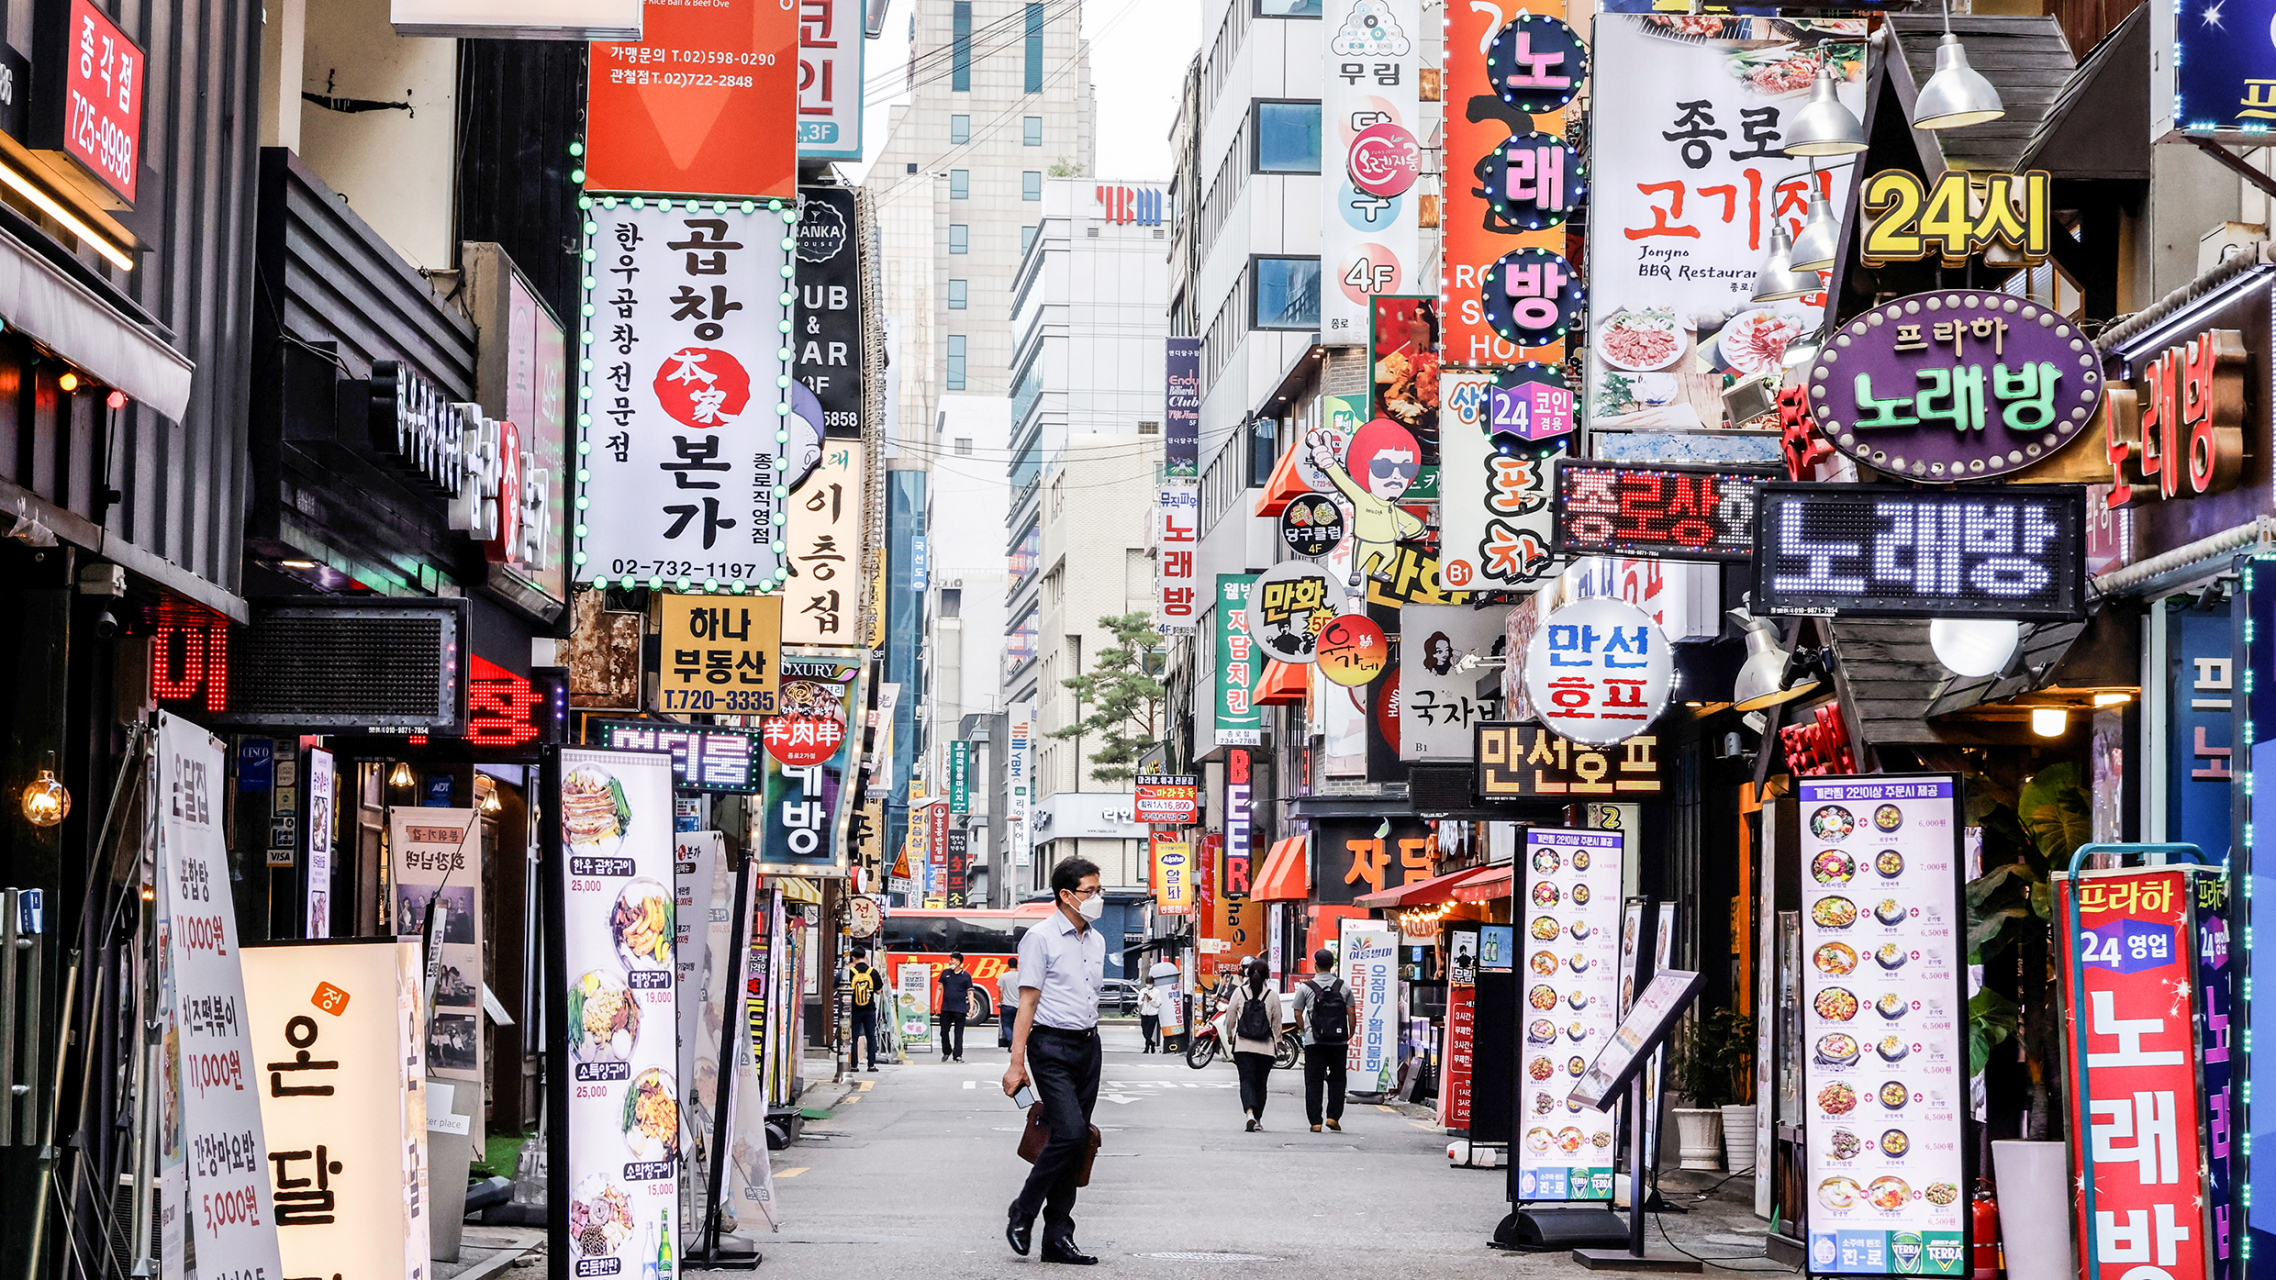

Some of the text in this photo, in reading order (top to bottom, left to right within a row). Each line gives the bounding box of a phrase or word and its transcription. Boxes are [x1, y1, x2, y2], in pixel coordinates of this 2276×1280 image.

[80, 14, 133, 114] 종각점
[610, 46, 776, 66] 가맹문의 T.02)598-0290
[610, 69, 650, 85] 관철점
[664, 72, 753, 89] 02)722-2848
[1339, 62, 1400, 86] 무림
[72, 89, 132, 186] 725-9998
[1662, 100, 1795, 169] 종로
[1505, 31, 1570, 330] 노래방
[1867, 173, 2048, 253] 24시
[1638, 244, 1690, 262] Jongno
[666, 218, 743, 341] 곱창
[1345, 257, 1394, 293] 4F
[1638, 264, 1673, 281] BBQ
[807, 316, 820, 334] &
[1331, 318, 1349, 328] 종로
[1894, 317, 2008, 357] 프라하
[666, 350, 741, 425] 本家
[1169, 369, 1199, 395] Endy
[1169, 396, 1199, 407] Club
[1534, 392, 1567, 417] 코인
[1853, 361, 2064, 431] 노래방
[1495, 393, 1529, 432] 24
[2107, 329, 2215, 509] 노래방
[1540, 418, 1563, 431] 겸용
[660, 435, 737, 550] 본가
[751, 452, 774, 545] 종로직영점
[1290, 502, 1338, 526] 武林
[1484, 455, 1550, 580] 포차
[1285, 526, 1341, 542] 당구클럽
[798, 482, 846, 635] 이층집
[1308, 543, 1322, 553] 4F
[1774, 500, 2057, 595] 노래방
[611, 558, 757, 580] 02-732-1197
[1164, 515, 1195, 616] 노래방
[1450, 565, 1470, 581] B1
[1263, 576, 1327, 623] 만화
[690, 608, 751, 642] 하나
[1158, 624, 1171, 634] 4F
[873, 650, 884, 659] 3F
[1319, 622, 1380, 672] 유가네
[1547, 625, 1648, 668] 만선
[673, 650, 766, 685] 부동산
[1226, 608, 1252, 714] 자담치킨
[664, 689, 774, 711] T.720-3335
[1547, 676, 1648, 720] 호프
[763, 718, 841, 747] 羊肉串
[243, 747, 269, 758] CESCO
[787, 752, 816, 761] 종로2가점
[1415, 743, 1428, 752] B1
[1011, 752, 1021, 777] YBM
[173, 753, 209, 825] 온달집
[432, 782, 449, 792] ADT
[1156, 788, 1196, 798] 마라중독
[1814, 785, 1938, 799] 계란찜 2인이상 주문시 제공
[1228, 749, 1250, 892] BEER
[1919, 819, 1946, 828] 6,000원
[1537, 834, 1613, 847] 계란찜 2인이상 주문시 제공
[271, 852, 291, 861] VISA
[686, 845, 701, 859] 본가
[1162, 855, 1186, 865] Alpha
[573, 858, 632, 876] 한우 곱창구이
[949, 856, 965, 889] 호프
[1920, 863, 1947, 871] 7,000원
[180, 856, 210, 902] 홍합탕
[571, 881, 601, 892] 25,000
[1166, 870, 1181, 900] 알파
[2078, 879, 2174, 914] 프라하
[1160, 906, 1182, 914] 종로점
[177, 914, 227, 961] 11,000원
[1921, 929, 1948, 937] 6,500원
[2081, 930, 2121, 968] 24
[2127, 933, 2168, 961] 영업
[2201, 927, 2216, 965] 24
[631, 973, 669, 988] 대창구이
[1921, 971, 1949, 980] 6,500원
[646, 992, 672, 1003] 19,000
[183, 996, 238, 1038] 치즈떡볶이
[1922, 1022, 1951, 1030] 6,500원
[187, 1050, 244, 1099] 11,000원
[578, 1064, 629, 1080] 소특양구이
[1923, 1066, 1952, 1074] 6,500원
[577, 1086, 607, 1098] 25,000
[1924, 1113, 1953, 1121] 6,500원
[2087, 990, 2190, 1280] 노래방
[193, 1130, 257, 1178] 간장마요밥
[1925, 1142, 1954, 1151] 6,500원
[625, 1164, 671, 1180] 소막창구이
[647, 1184, 674, 1196] 15,000
[1591, 1178, 1612, 1189] TERRA
[202, 1185, 260, 1240] 5,000원
[1928, 1217, 1956, 1226] 6,500원
[1842, 1249, 1883, 1266] 진-로
[1893, 1245, 1920, 1254] TERRA
[1927, 1246, 1963, 1260] TERRA
[579, 1259, 618, 1276] 모듬한판
